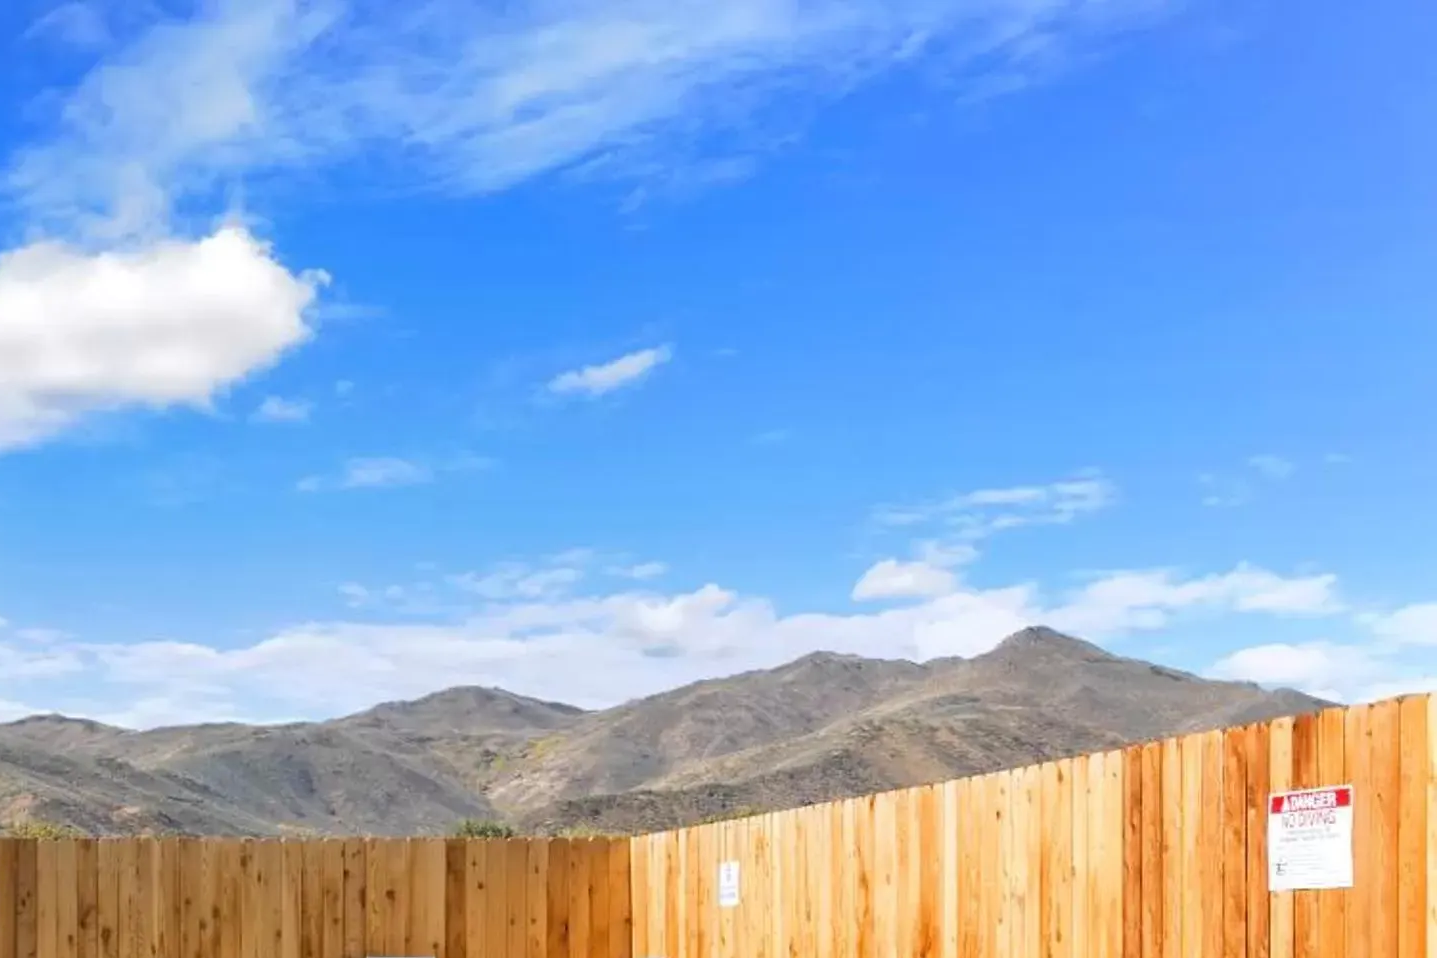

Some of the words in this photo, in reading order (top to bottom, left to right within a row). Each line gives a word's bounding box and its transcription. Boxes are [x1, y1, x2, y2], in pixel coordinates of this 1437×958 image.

[1289, 791, 1336, 812] DANGER
[1281, 812, 1296, 829] NO
[1298, 808, 1336, 828] DIVING
